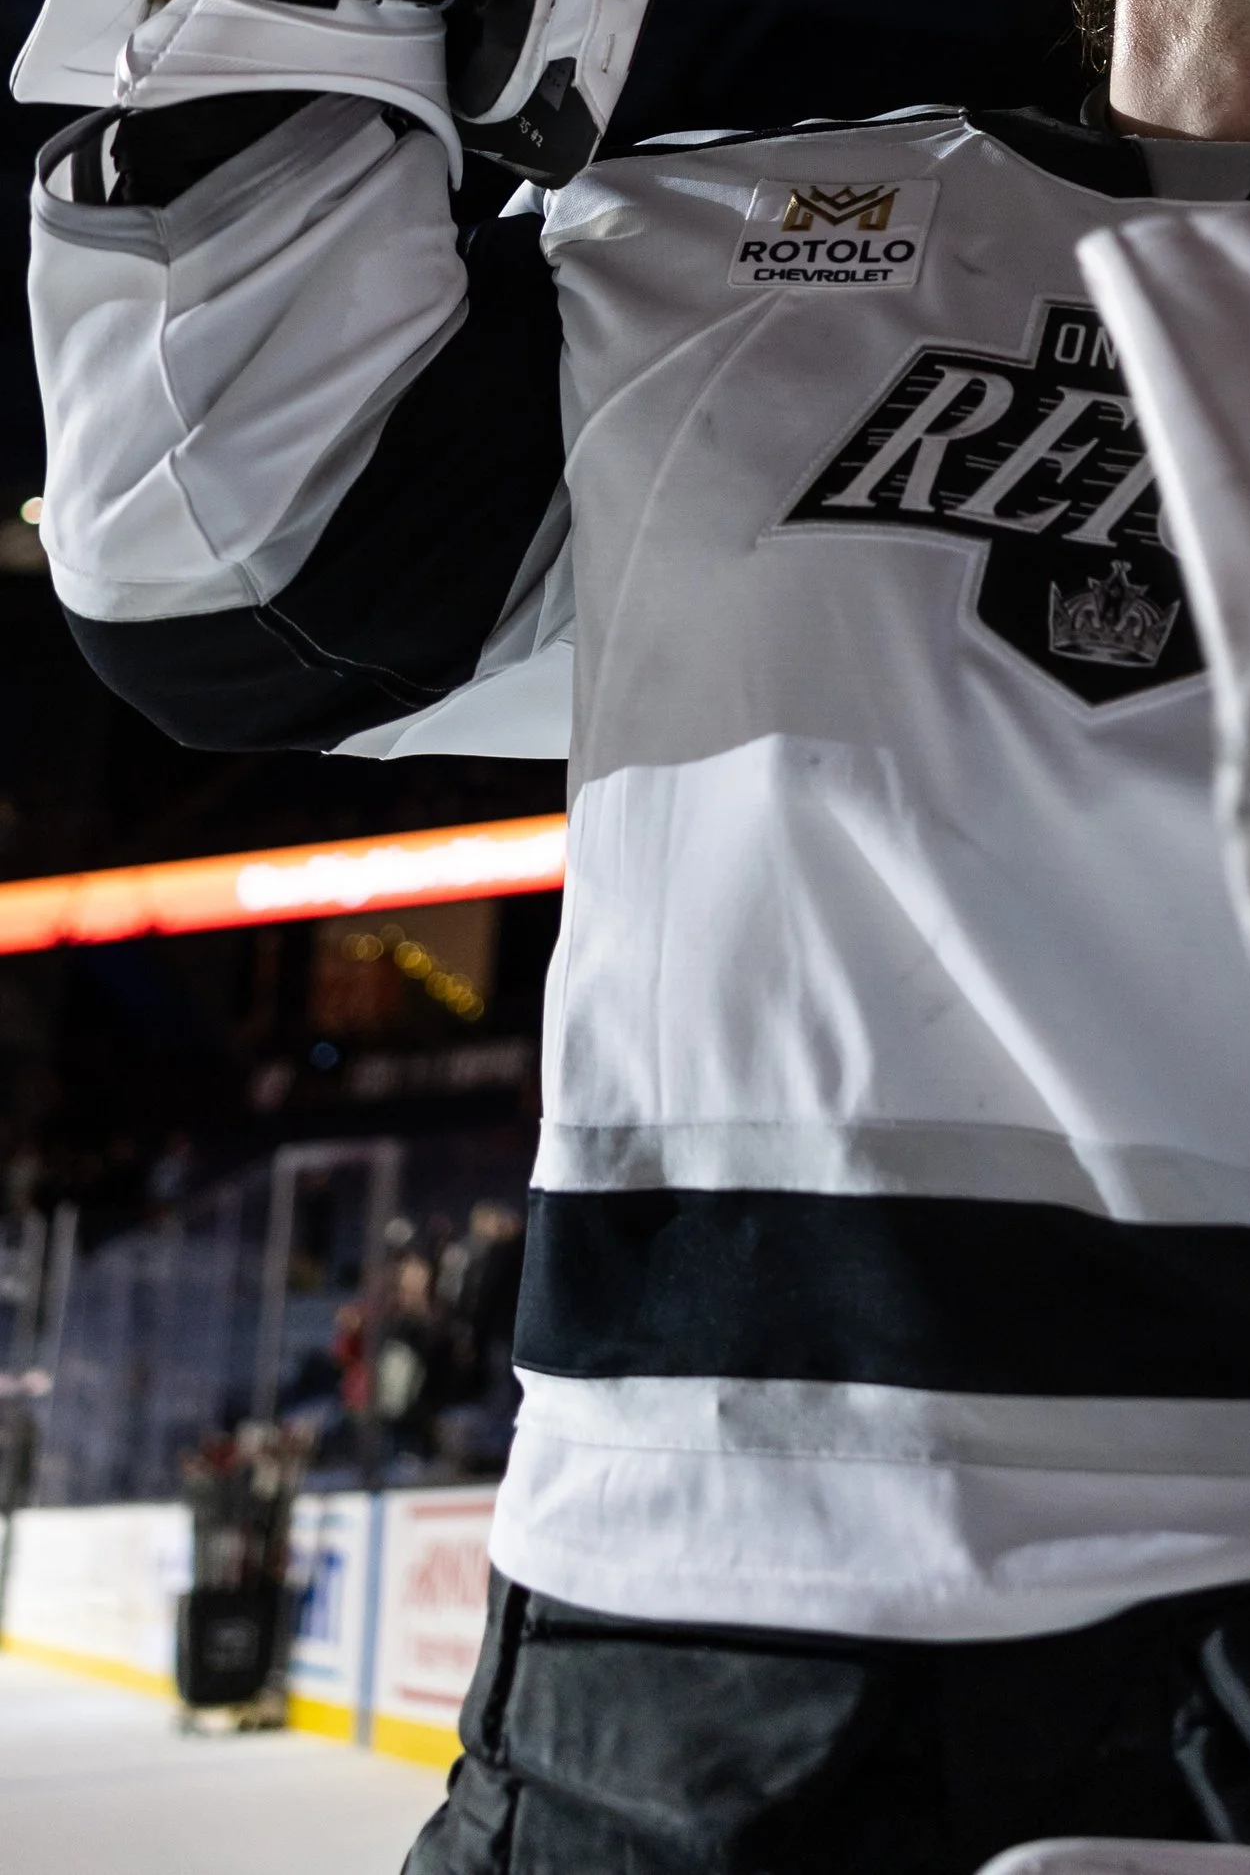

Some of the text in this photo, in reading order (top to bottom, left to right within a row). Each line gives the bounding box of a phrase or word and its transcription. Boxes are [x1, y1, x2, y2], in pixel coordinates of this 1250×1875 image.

[739, 238, 915, 264] ROTOLO
[753, 268, 893, 283] CHEVROLET
[820, 364, 1178, 553] REI
